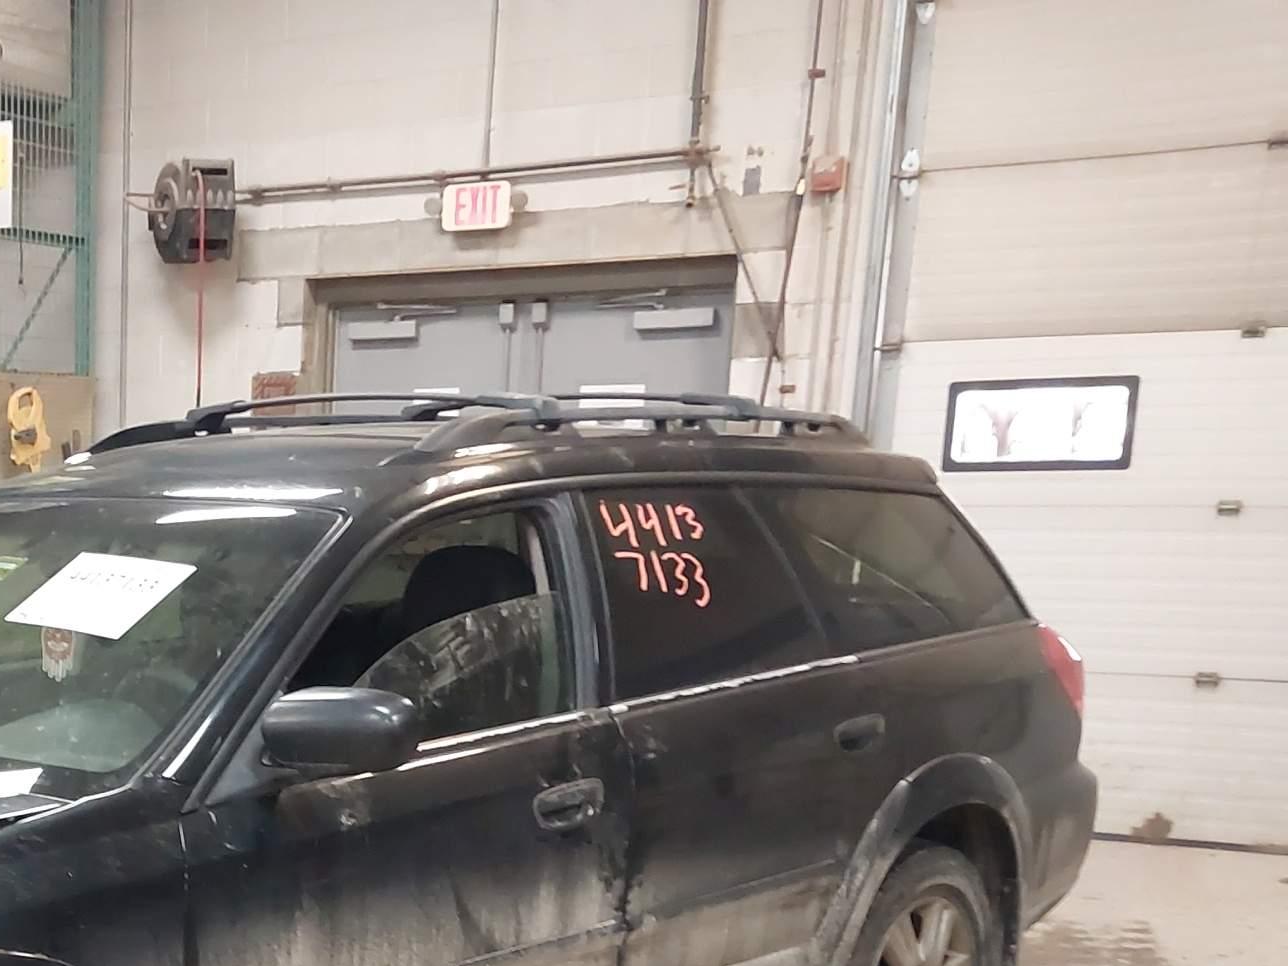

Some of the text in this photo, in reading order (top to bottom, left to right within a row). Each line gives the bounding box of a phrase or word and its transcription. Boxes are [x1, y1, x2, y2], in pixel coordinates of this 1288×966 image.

[454, 184, 501, 225] EXIT
[599, 499, 704, 548] 4413
[613, 549, 711, 608] 7133
